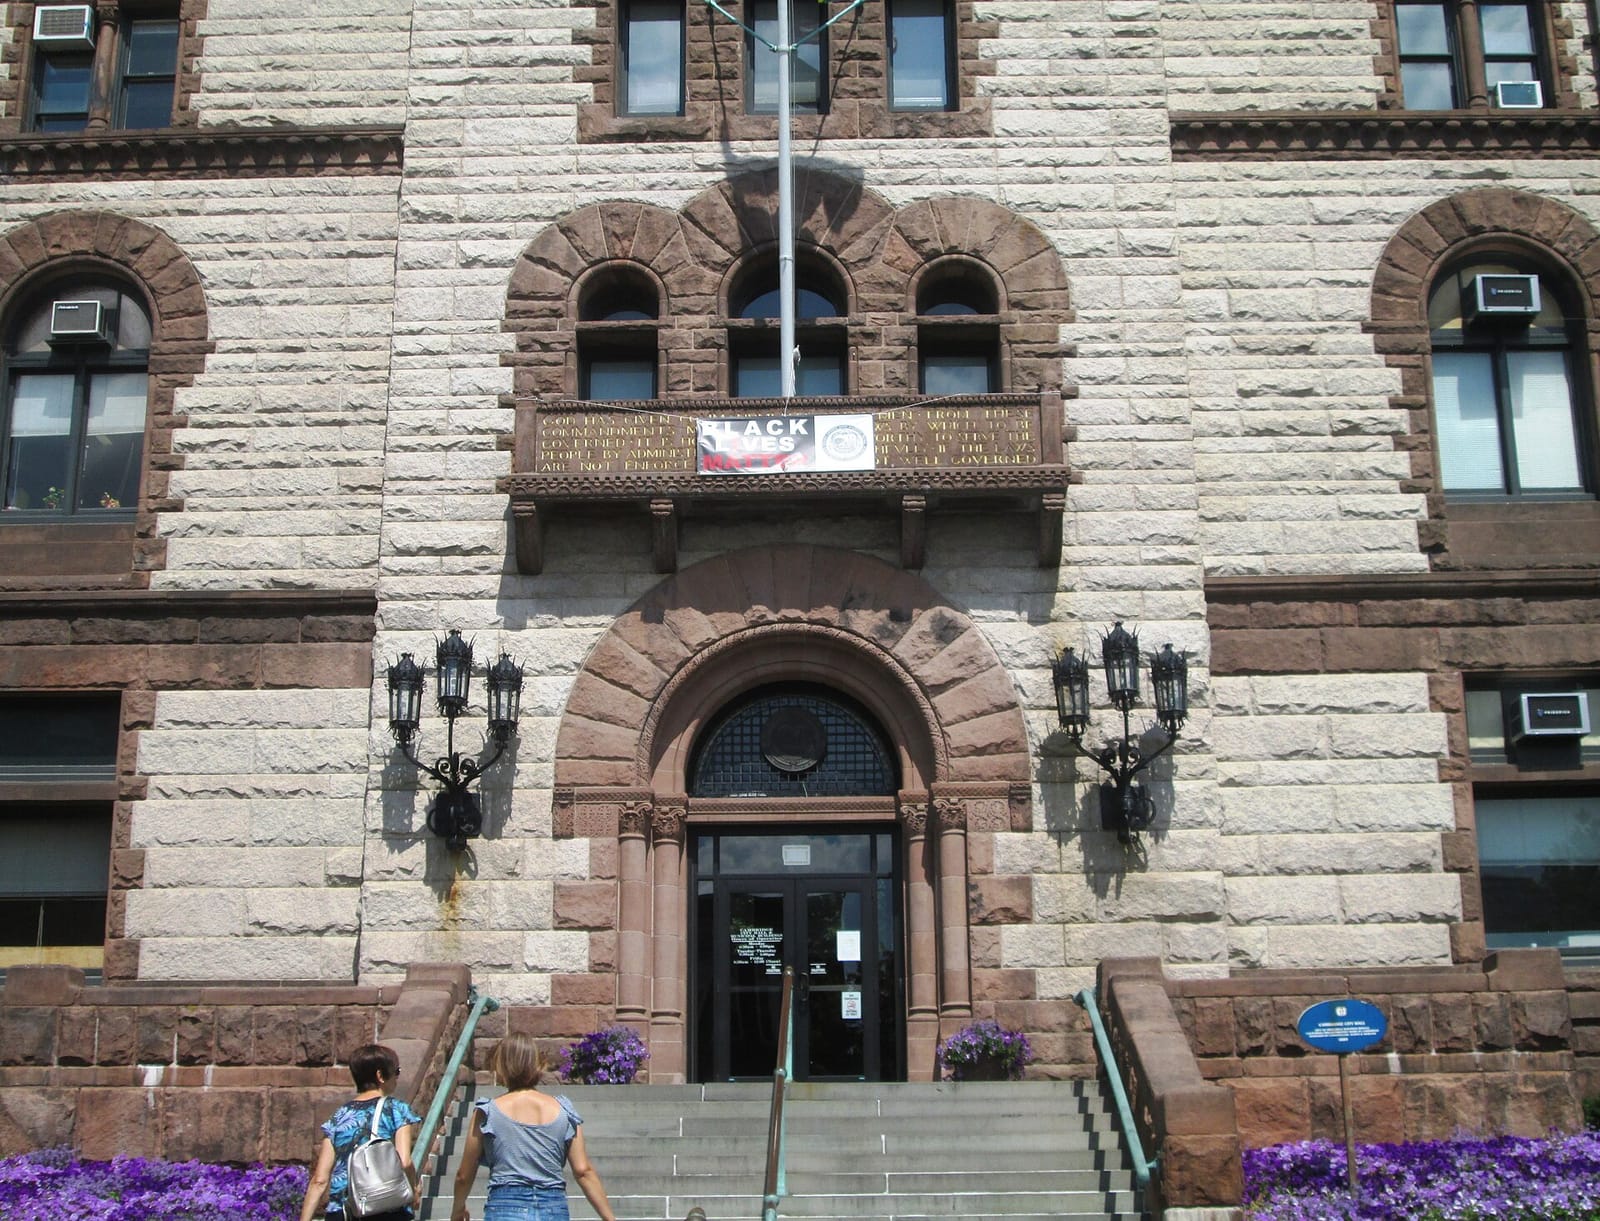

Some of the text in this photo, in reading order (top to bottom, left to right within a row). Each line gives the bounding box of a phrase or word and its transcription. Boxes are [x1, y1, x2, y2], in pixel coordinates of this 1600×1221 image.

[542, 416, 576, 426] GOD
[584, 415, 616, 426] HAS
[624, 414, 670, 425] GIVEN
[927, 409, 969, 419] FROM
[985, 409, 1034, 419] THESE
[542, 425, 676, 437] COMMANDMENTS
[701, 419, 808, 436] BLACK
[928, 421, 976, 431] WHICH
[989, 420, 1007, 430] TO
[1016, 420, 1034, 430] BE
[875, 432, 923, 443] ORTHY
[935, 432, 953, 442] TO
[958, 431, 1000, 442] SERVE
[541, 449, 596, 460] PEOPLE
[603, 449, 620, 459] BY
[900, 454, 943, 465] WELL
[951, 454, 1036, 465] GOVERNED
[541, 460, 695, 472] ARE NOT ENFORCE
[703, 453, 808, 471] MATT
